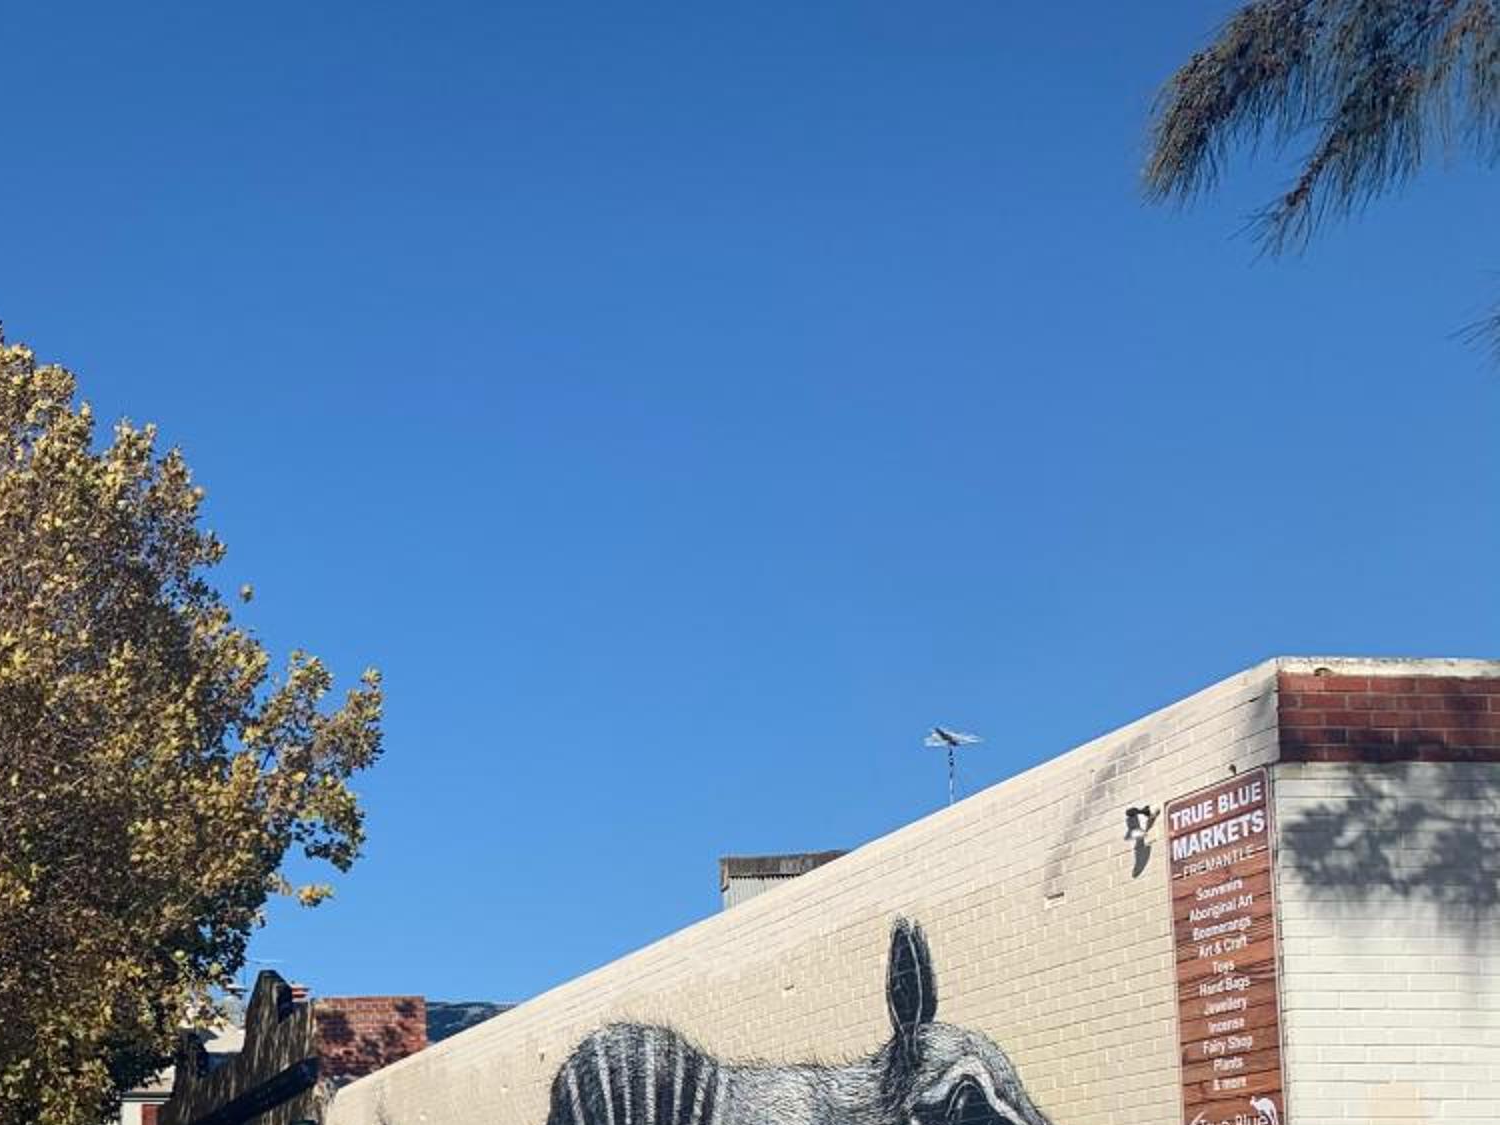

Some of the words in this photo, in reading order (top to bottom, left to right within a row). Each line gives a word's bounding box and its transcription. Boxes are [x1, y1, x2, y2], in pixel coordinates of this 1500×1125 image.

[1170, 800, 1213, 831] TRUE
[1218, 781, 1262, 813] BLUE
[1173, 810, 1265, 862] MARKETS
[1183, 844, 1253, 880] FREMANTLE
[1189, 898, 1237, 923] Aboriginal
[1238, 893, 1253, 909] Art
[1212, 960, 1235, 975] Toys
[1203, 1039, 1227, 1055] Fairy
[1227, 1035, 1253, 1050] Shop
